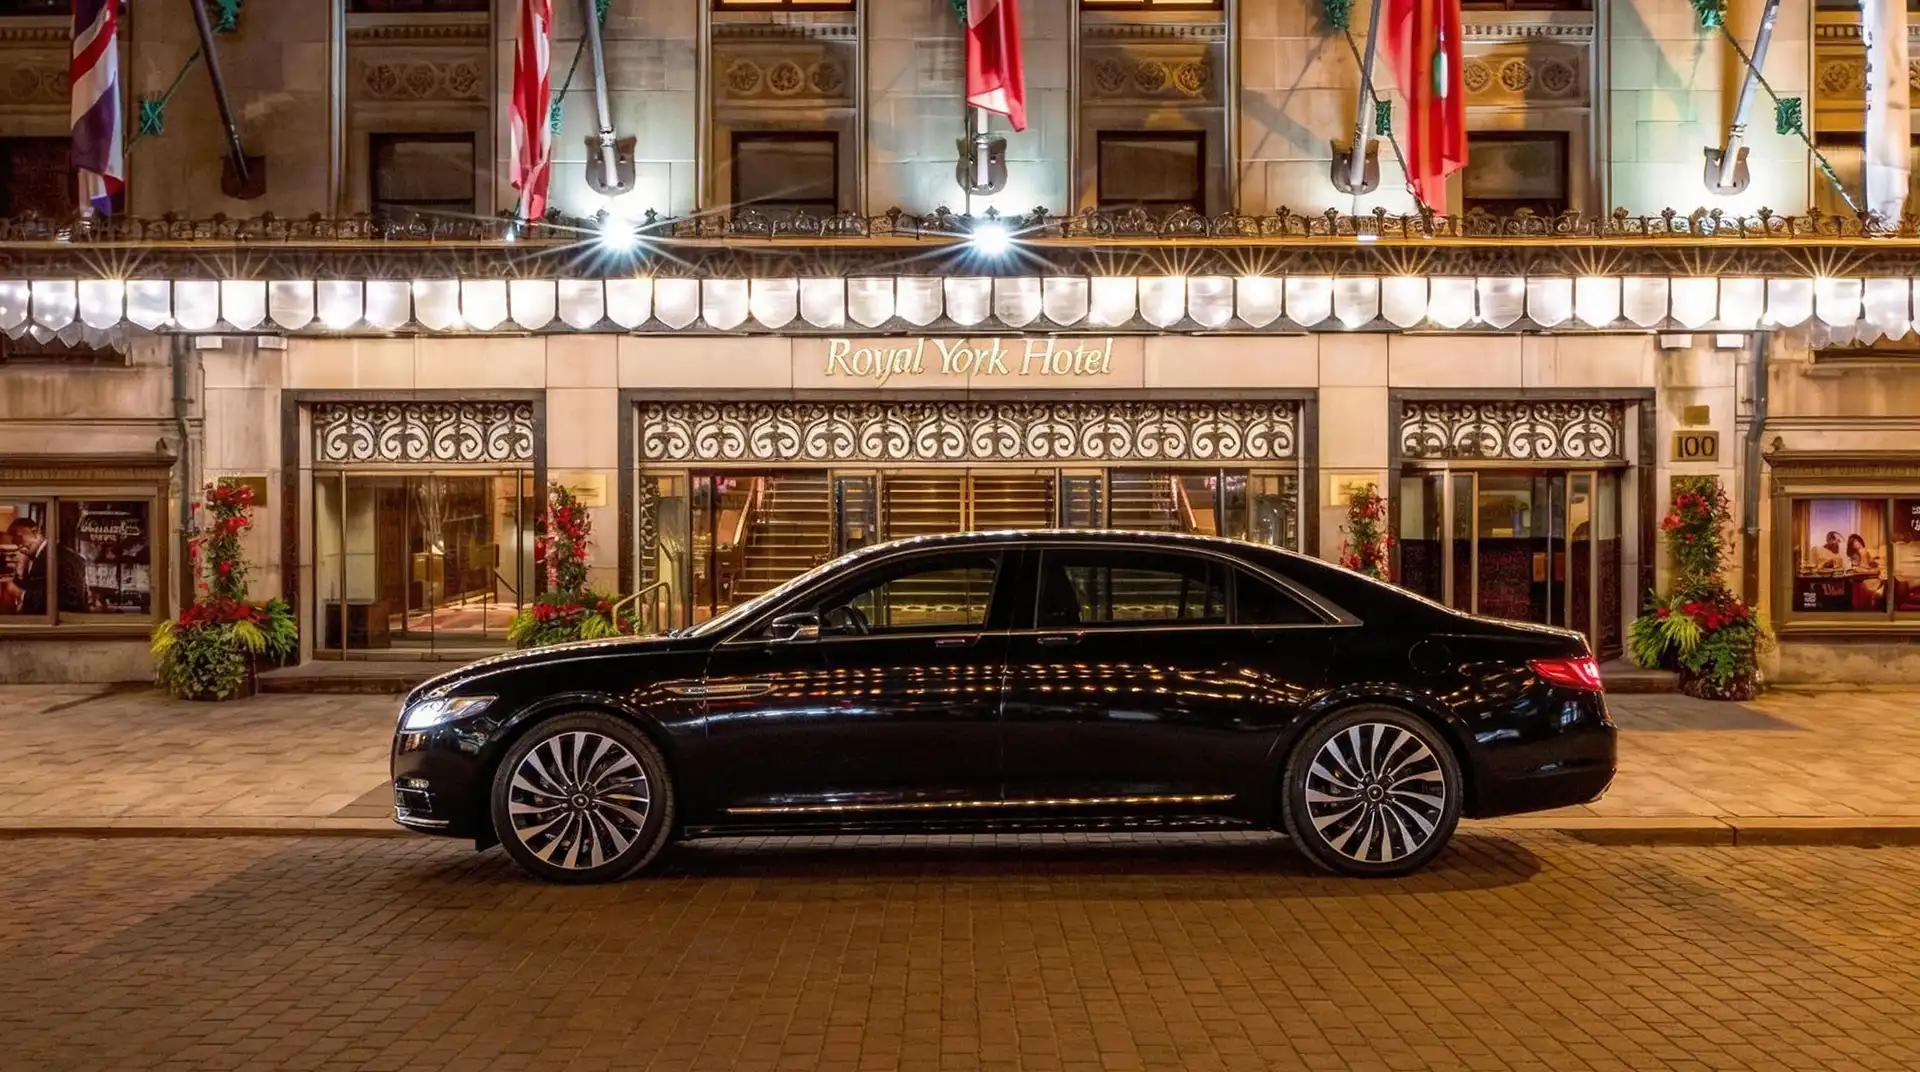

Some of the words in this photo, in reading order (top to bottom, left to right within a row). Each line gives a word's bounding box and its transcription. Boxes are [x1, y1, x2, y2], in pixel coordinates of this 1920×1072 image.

[825, 337, 925, 388] Royal
[931, 337, 1009, 375] York
[1018, 337, 1114, 375] Hotel
[1677, 435, 1715, 457] 100
